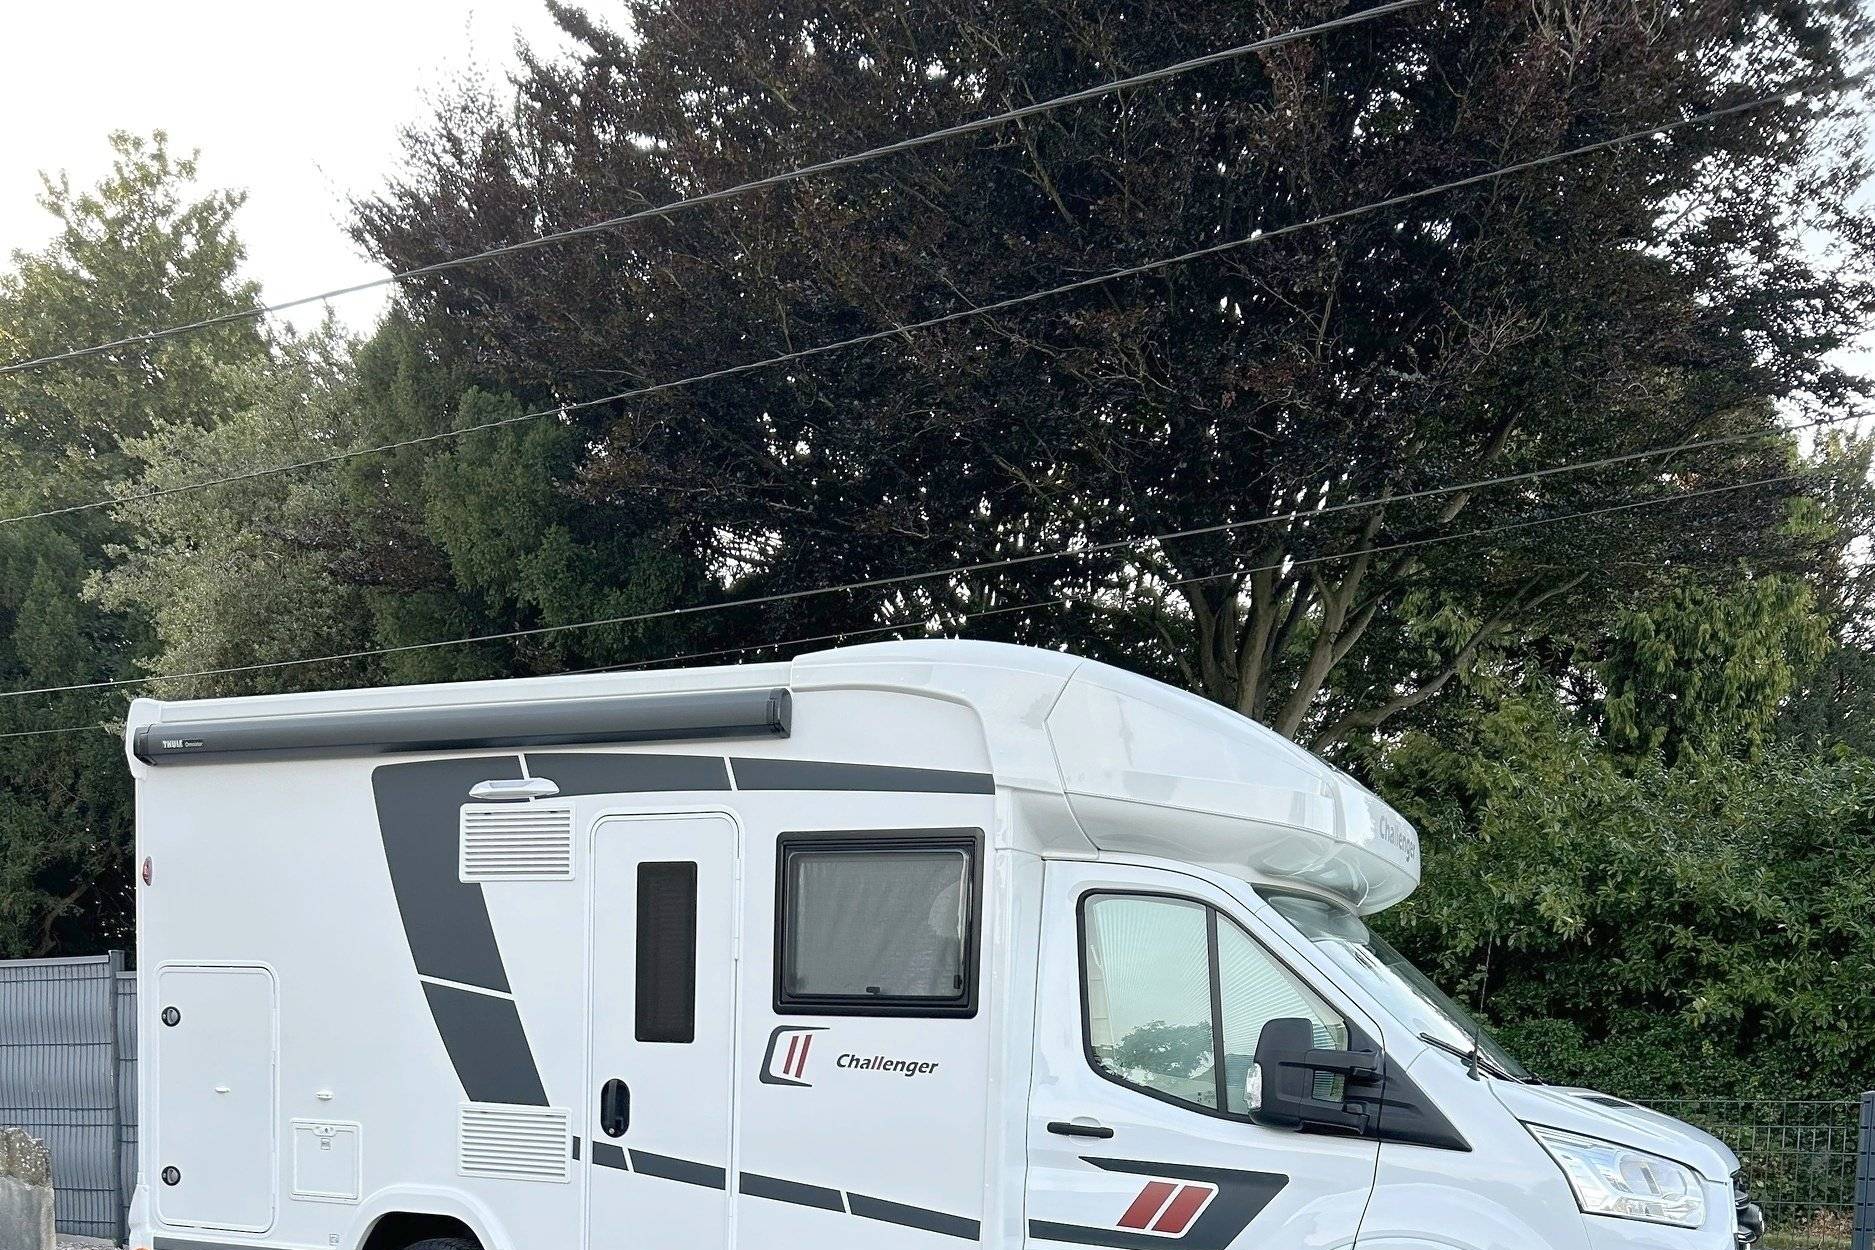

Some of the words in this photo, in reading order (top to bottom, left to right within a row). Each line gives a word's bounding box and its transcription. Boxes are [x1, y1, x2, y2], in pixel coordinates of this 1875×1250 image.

[163, 740, 183, 748] THULE
[1380, 815, 1416, 863] Challenger
[836, 1054, 938, 1077] Challenger
